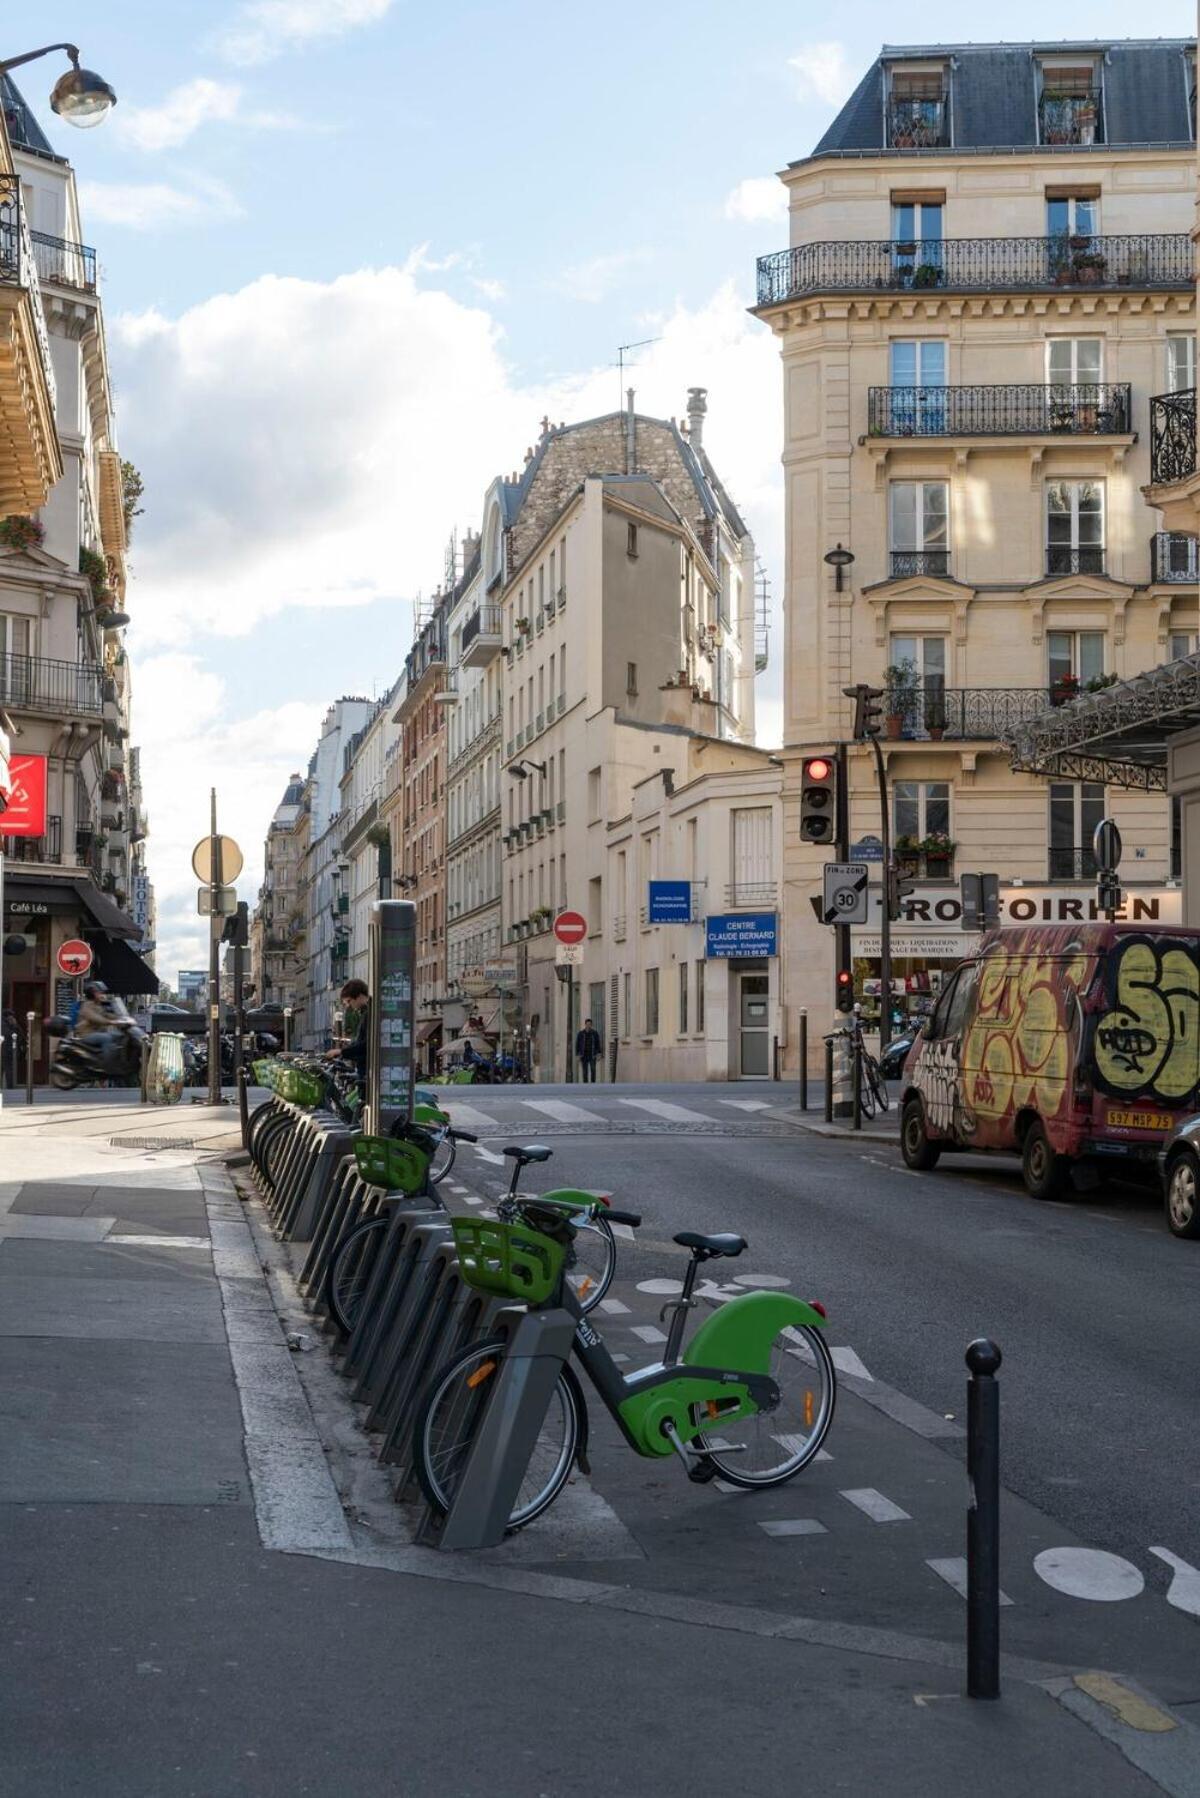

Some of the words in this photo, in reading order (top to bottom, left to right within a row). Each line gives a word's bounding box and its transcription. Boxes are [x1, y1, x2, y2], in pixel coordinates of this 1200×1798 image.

[838, 893, 854, 907] 30
[10, 903, 30, 912] Café
[32, 903, 48, 913] Léa
[727, 921, 757, 930] CENTRE
[708, 932, 738, 941] CLAUDE
[739, 931, 775, 940] BERNARD
